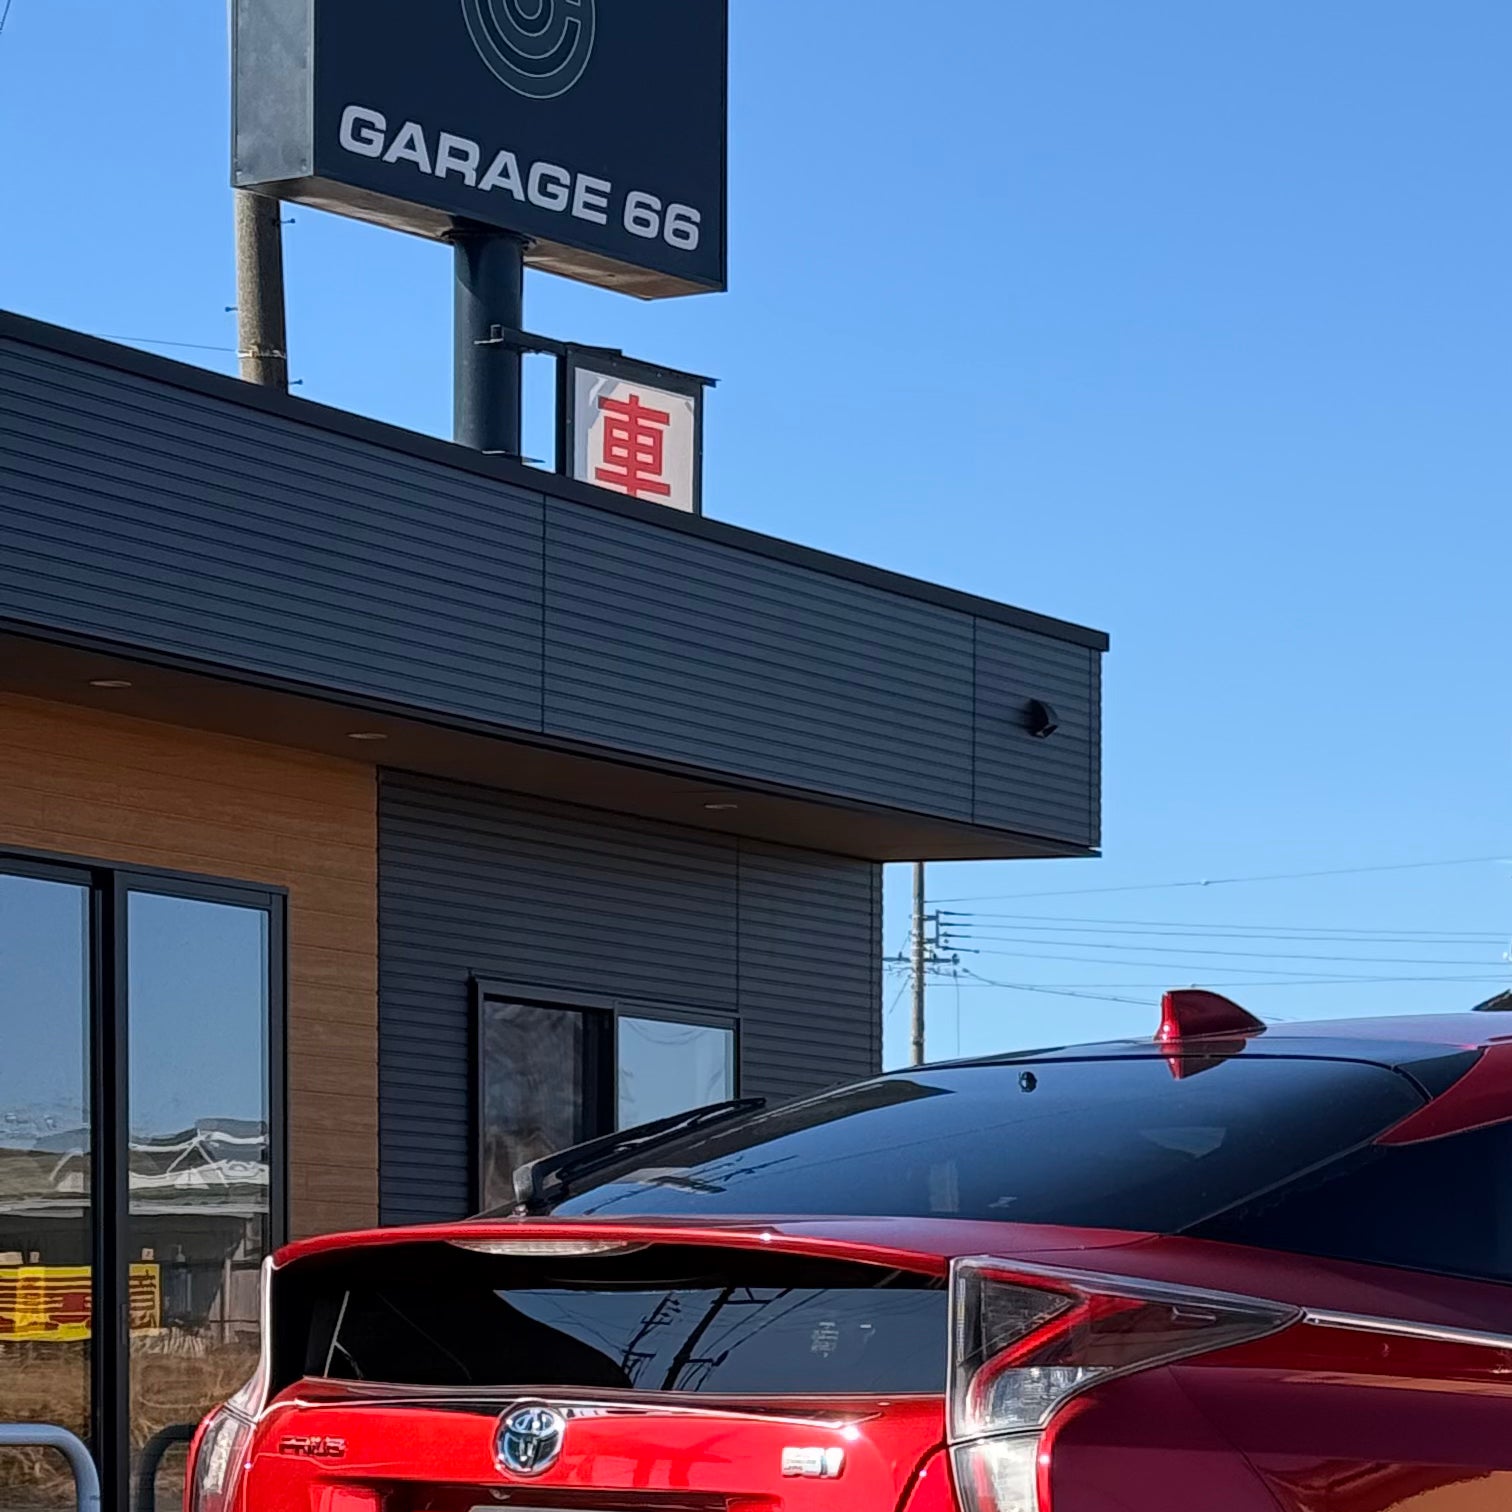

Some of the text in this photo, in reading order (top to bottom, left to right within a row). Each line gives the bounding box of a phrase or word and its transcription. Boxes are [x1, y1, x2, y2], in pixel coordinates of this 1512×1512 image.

[339, 104, 701, 251] GARAGE 66
[595, 393, 671, 497] 車
